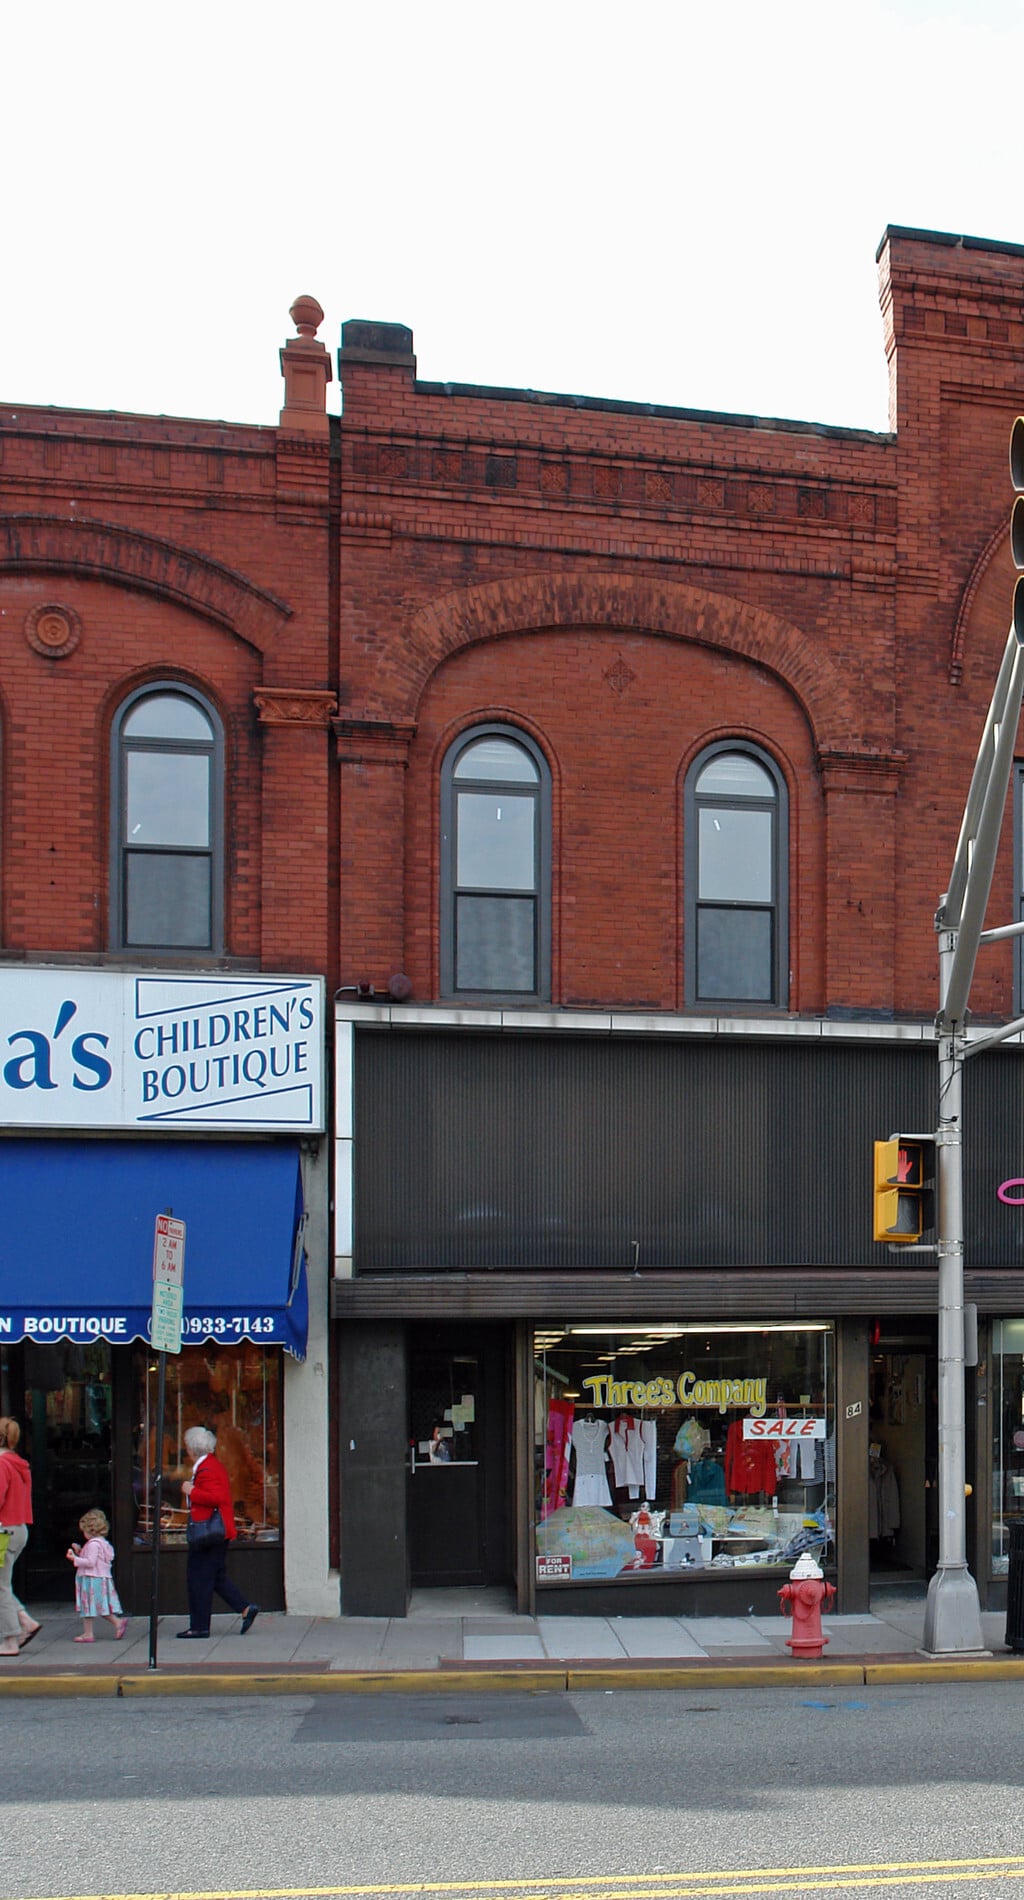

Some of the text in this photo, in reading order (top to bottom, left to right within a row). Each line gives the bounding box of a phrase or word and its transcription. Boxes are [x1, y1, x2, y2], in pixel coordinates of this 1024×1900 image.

[134, 997, 315, 1060] CHILDREN'S
[3, 1000, 113, 1091] a's
[142, 1041, 309, 1102] BOUTIQUE
[157, 1218, 169, 1233] NO
[169, 1238, 178, 1250] AM
[166, 1249, 174, 1261] TO
[167, 1262, 176, 1272] AM
[23, 1316, 127, 1334] BOUTIQUE
[582, 1370, 768, 1418] Three's Company
[847, 1403, 861, 1416] 84
[750, 1420, 817, 1436] SALE
[545, 1557, 563, 1565] FOR
[538, 1564, 570, 1574] RENT
